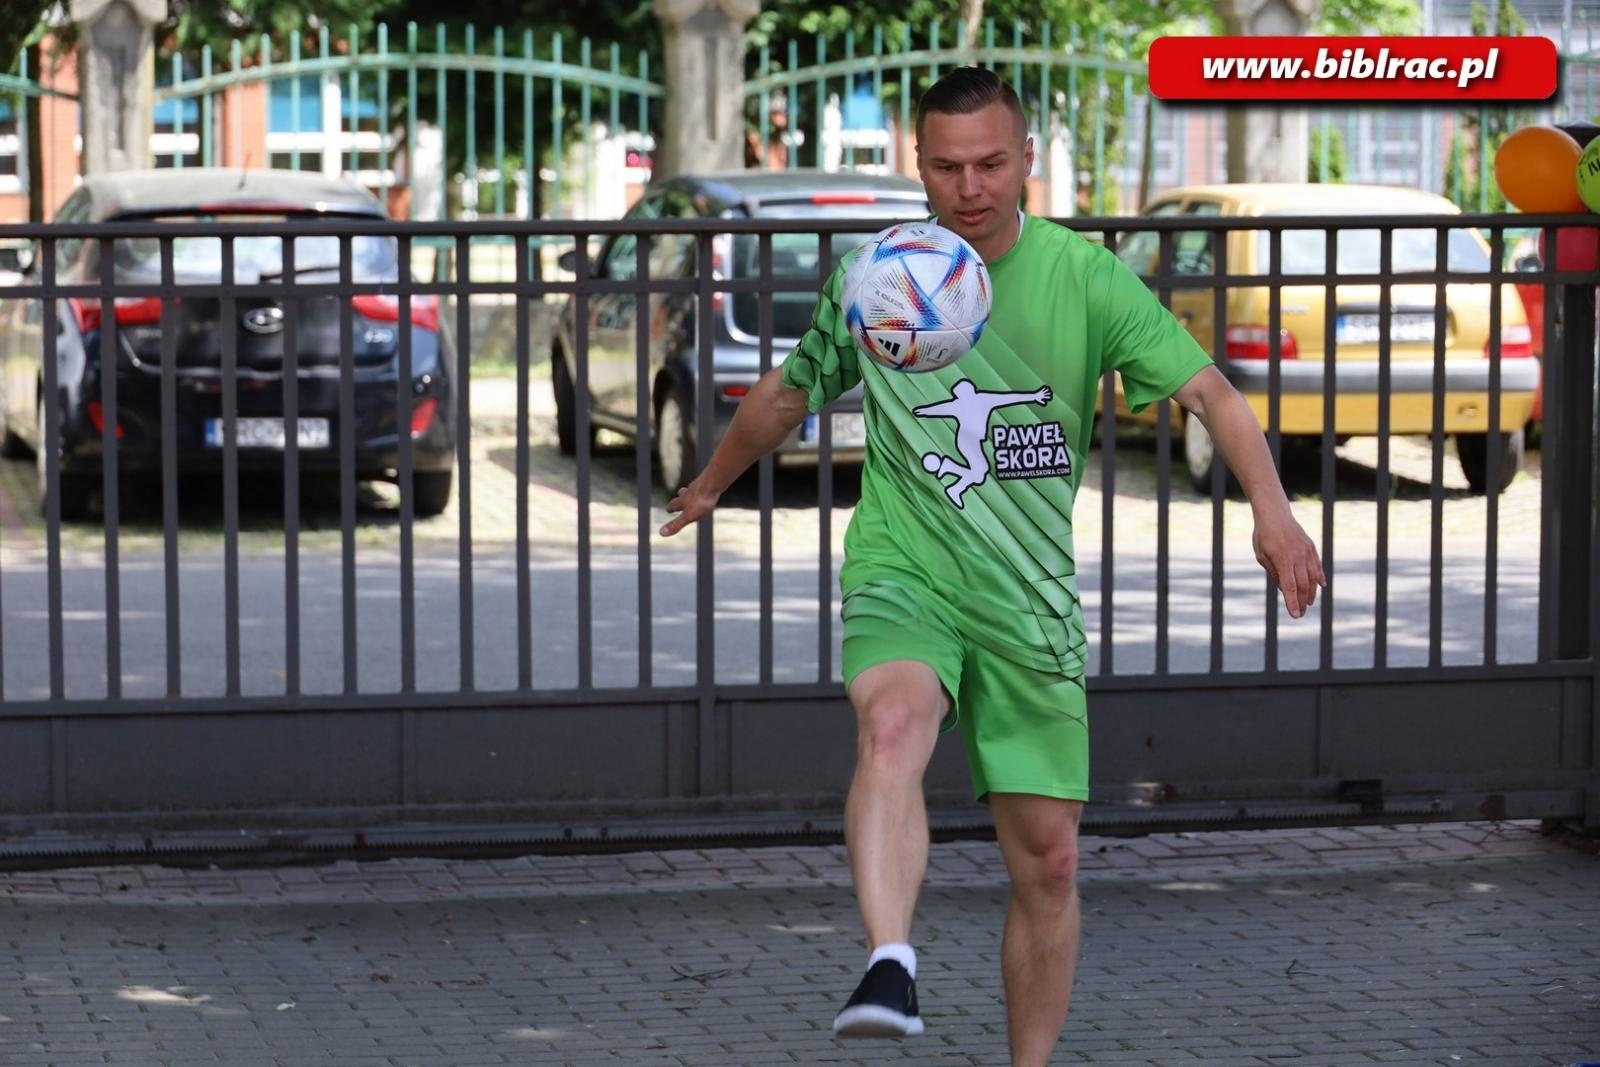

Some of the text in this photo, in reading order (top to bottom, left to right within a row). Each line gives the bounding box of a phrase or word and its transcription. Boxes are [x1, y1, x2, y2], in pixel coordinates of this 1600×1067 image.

[993, 424, 1065, 447] PAWEŁ
[995, 445, 1070, 470] SKÓRA
[997, 468, 1070, 478] WWW.PAWELSKORA.COM
